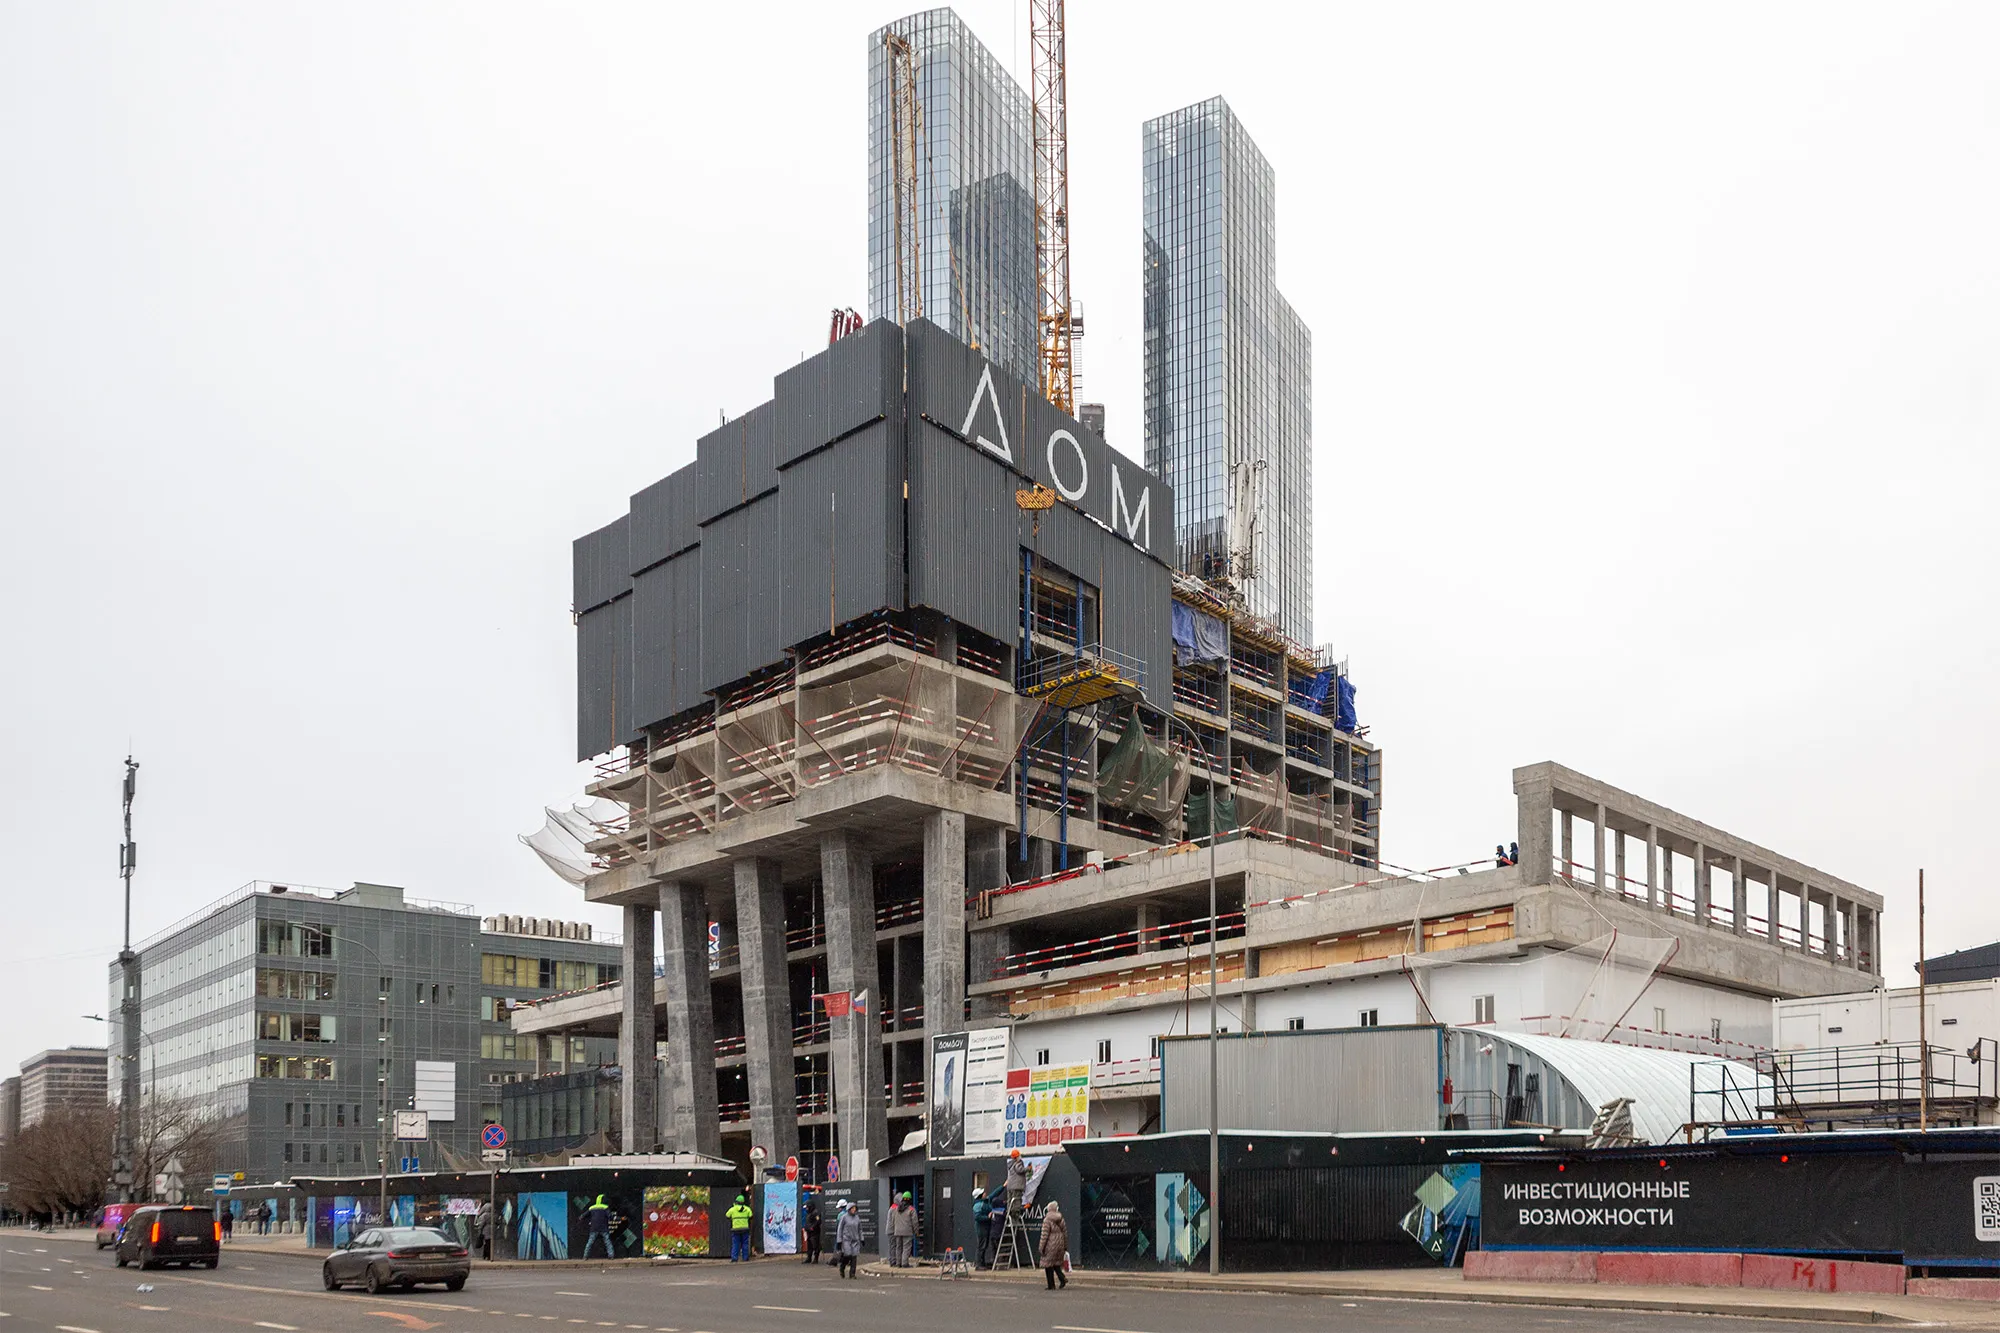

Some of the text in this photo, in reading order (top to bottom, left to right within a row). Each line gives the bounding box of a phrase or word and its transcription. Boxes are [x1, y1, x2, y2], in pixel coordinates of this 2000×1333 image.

[961, 363, 1150, 550] ДОМ
[1503, 1181, 1690, 1201] ИНВЕСТИЦИОННЫЕ
[1519, 1208, 1673, 1225] ВОЗМОЖНОСТИ
